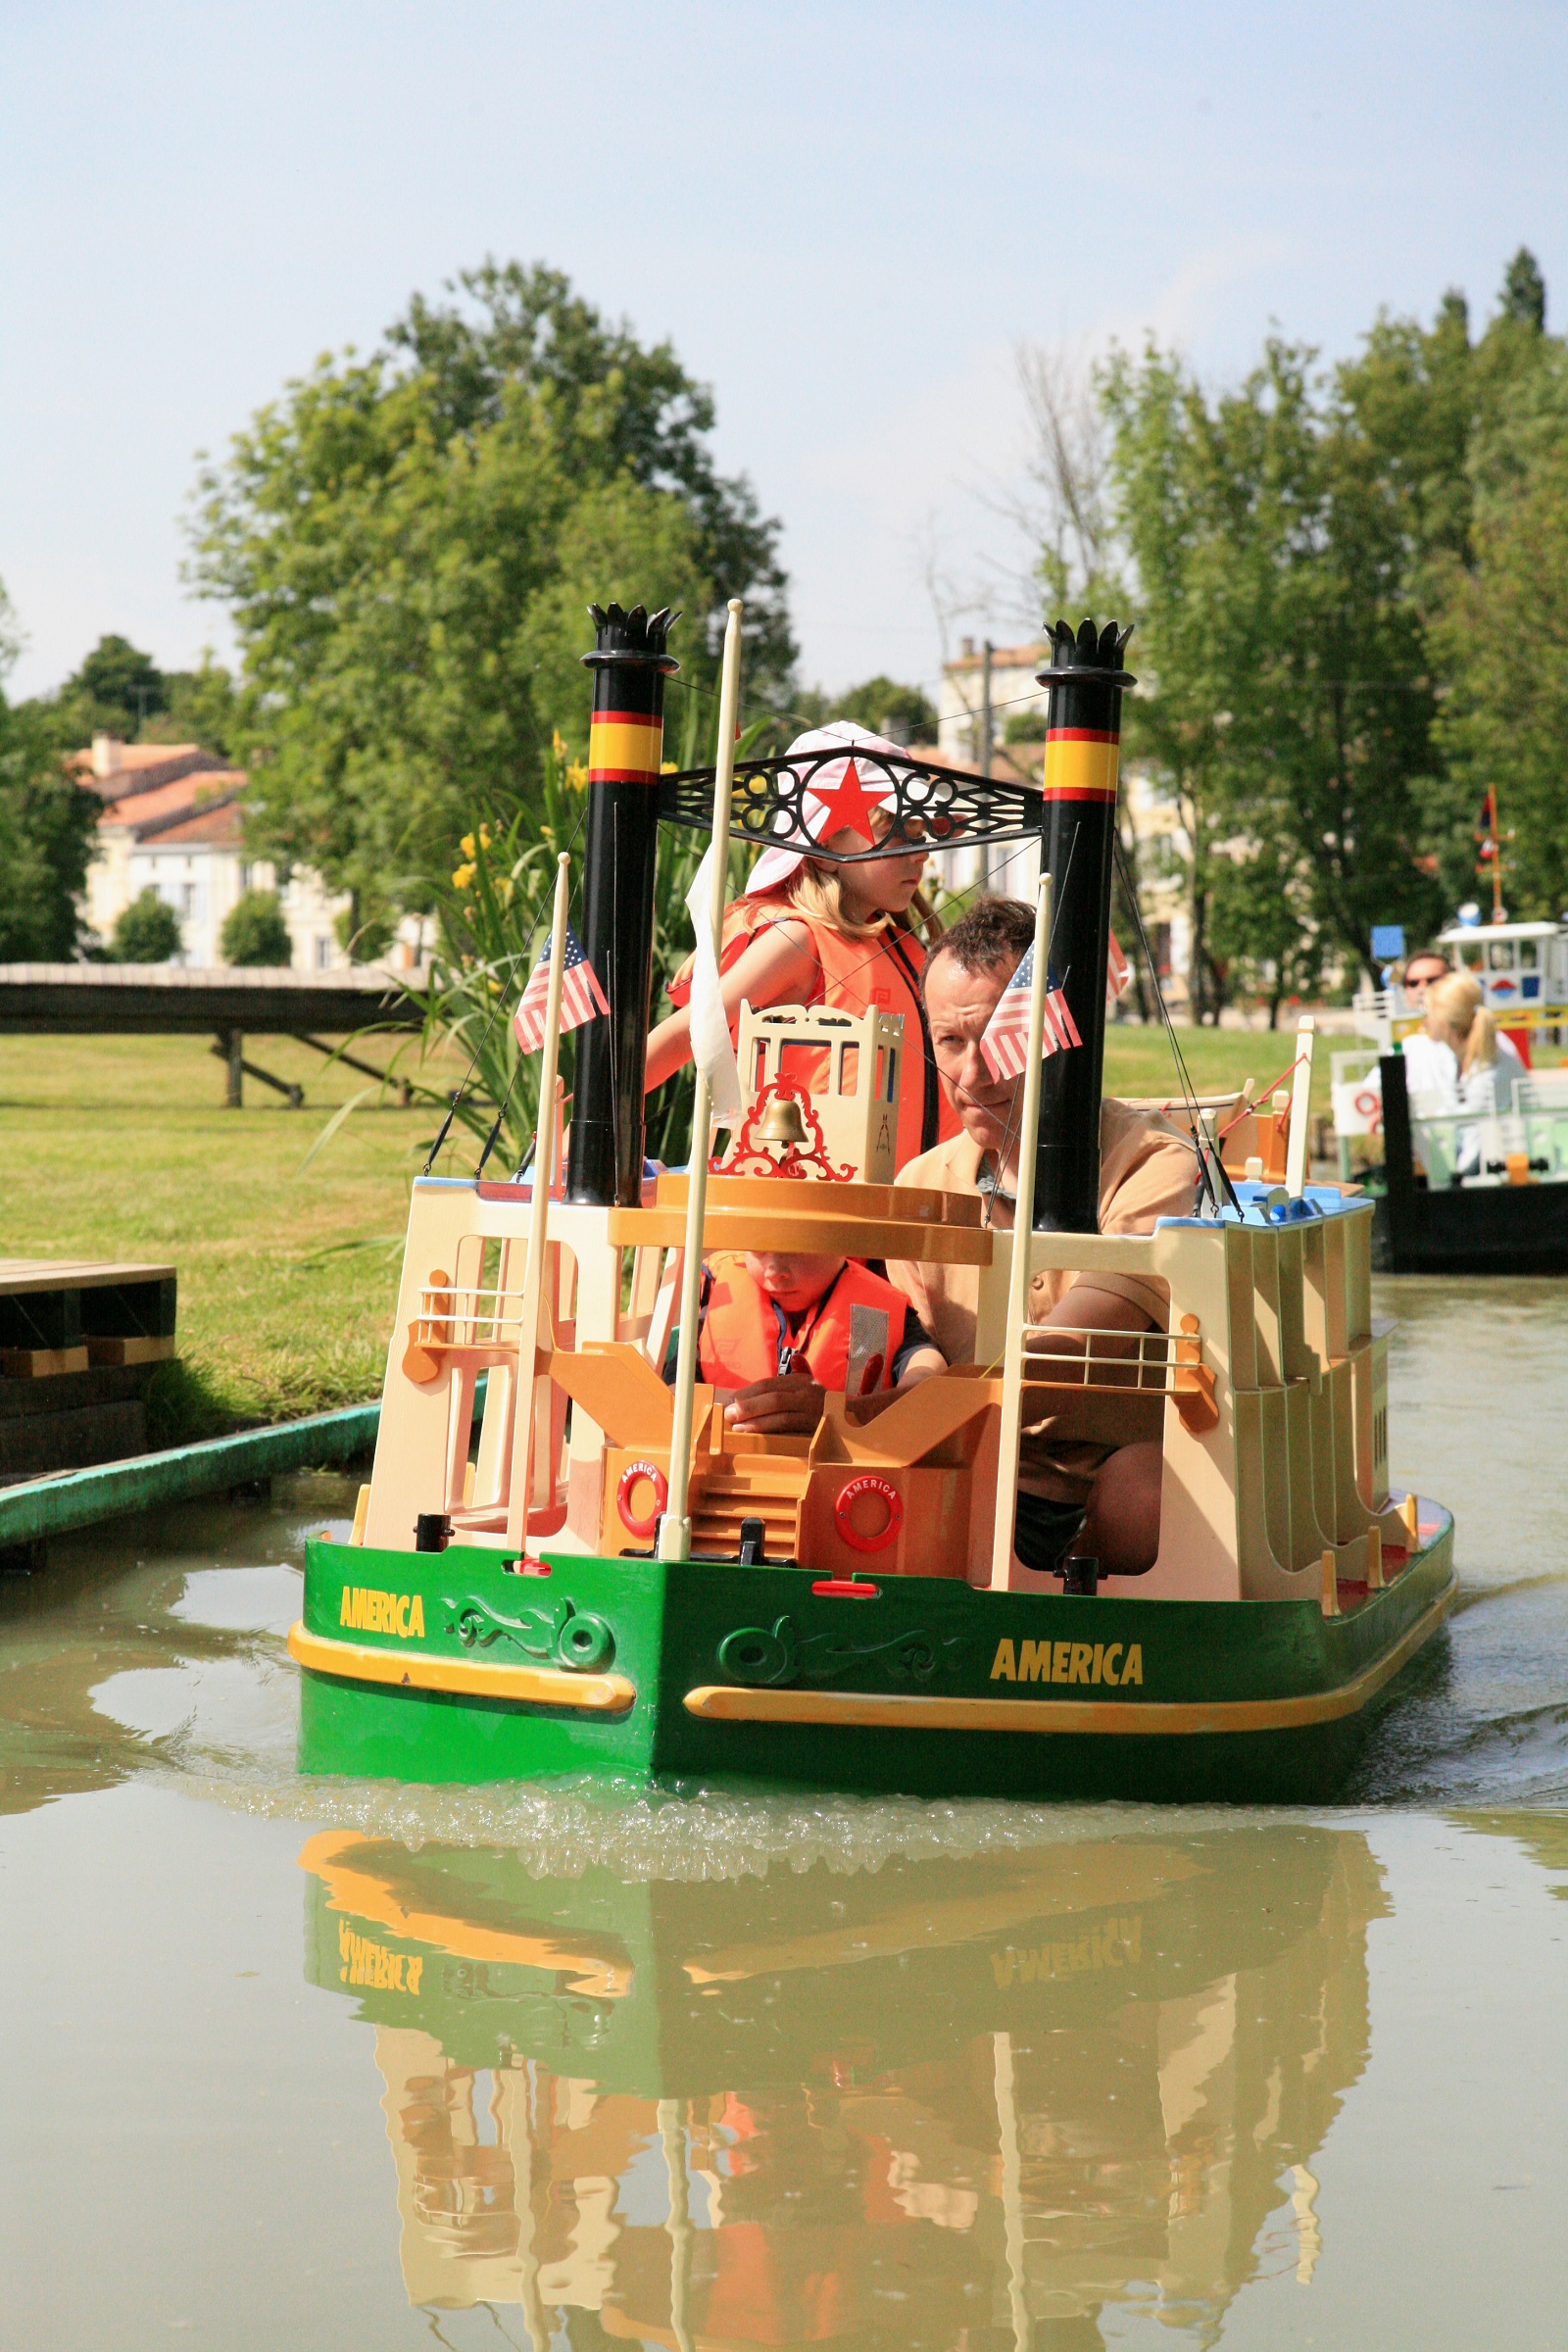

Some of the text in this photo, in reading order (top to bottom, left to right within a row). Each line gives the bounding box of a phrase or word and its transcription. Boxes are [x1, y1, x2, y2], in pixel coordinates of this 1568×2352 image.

[621, 1462, 658, 1484] AMERICA
[846, 1479, 897, 1500] AMERICA
[339, 1585, 425, 1639] AMERICA
[989, 1638, 1144, 1687] AMERICA
